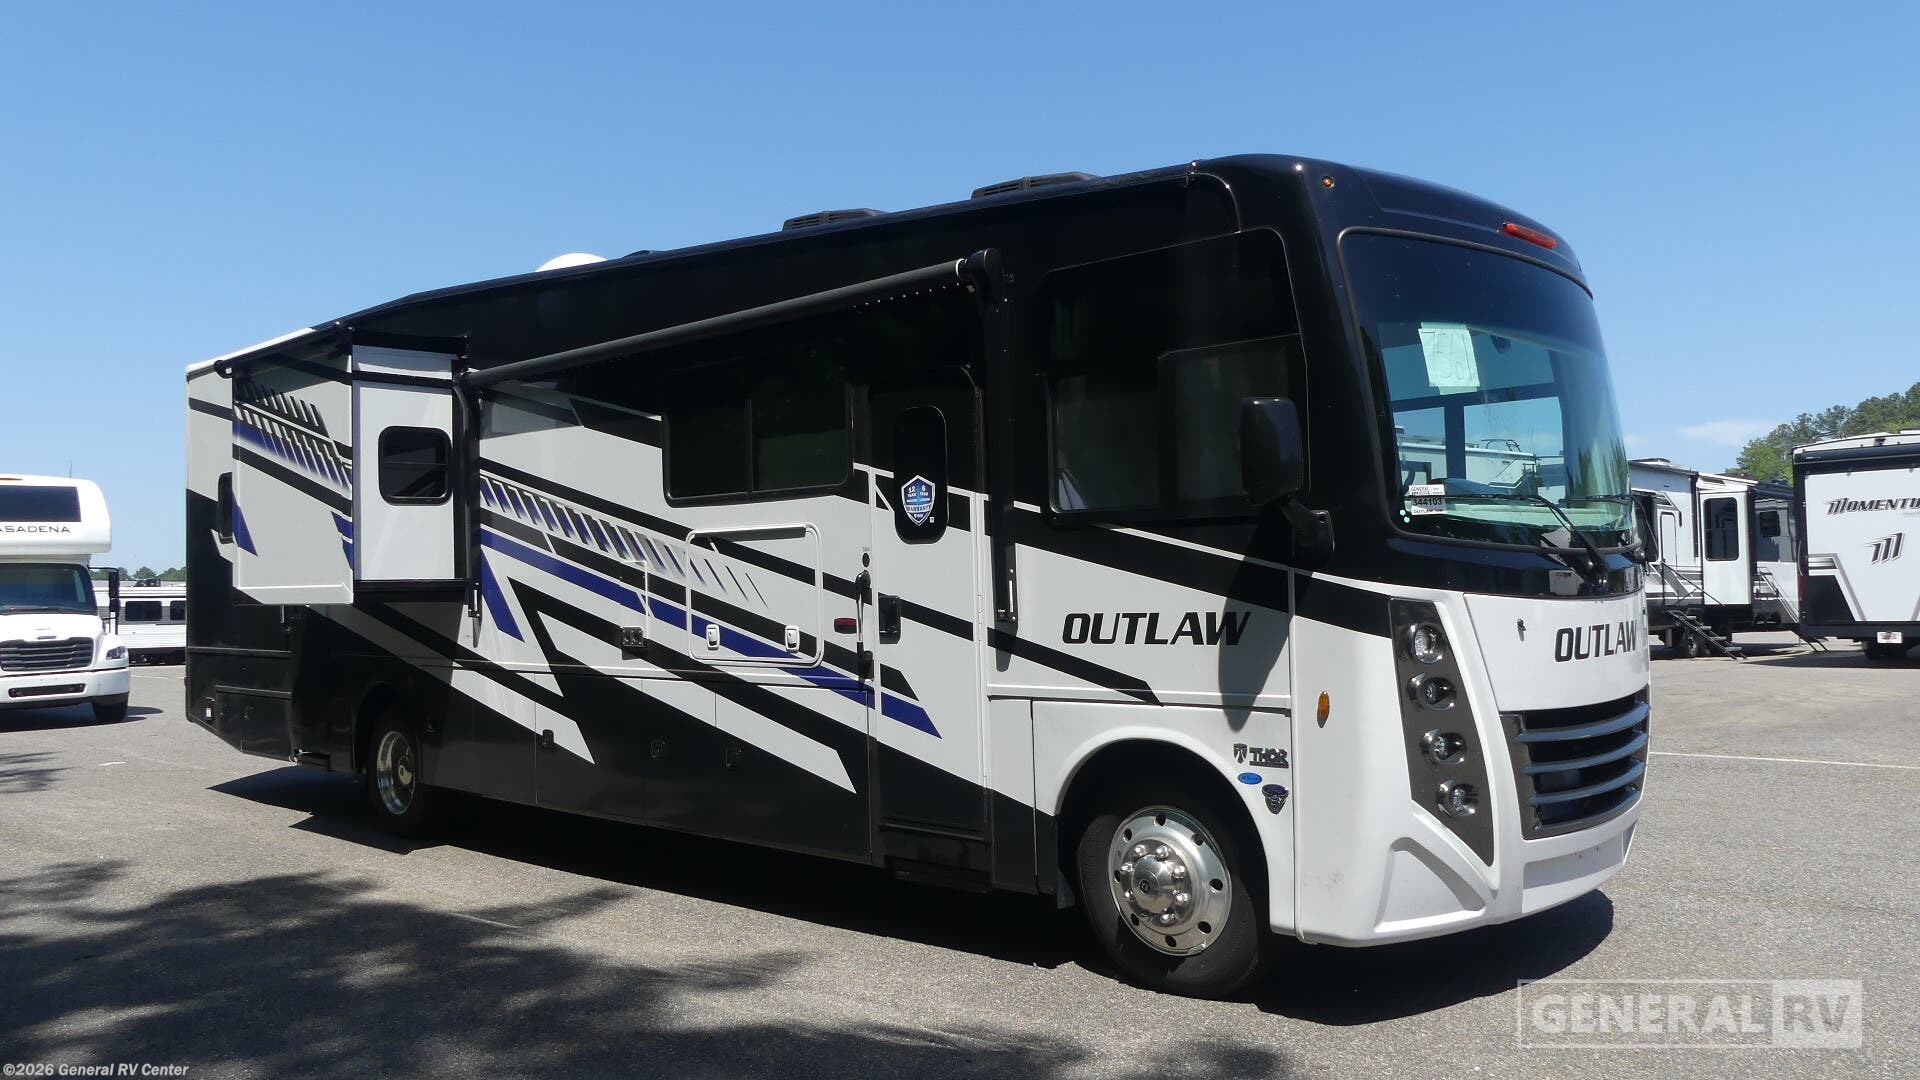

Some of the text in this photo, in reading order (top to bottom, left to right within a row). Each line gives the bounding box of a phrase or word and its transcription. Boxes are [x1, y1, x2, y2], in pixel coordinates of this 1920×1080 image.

[1412, 498, 1443, 506] 344103
[1062, 611, 1251, 646] OUTLAW
[1554, 619, 1638, 663] OUTLAW
[1248, 746, 1289, 764] THOR
